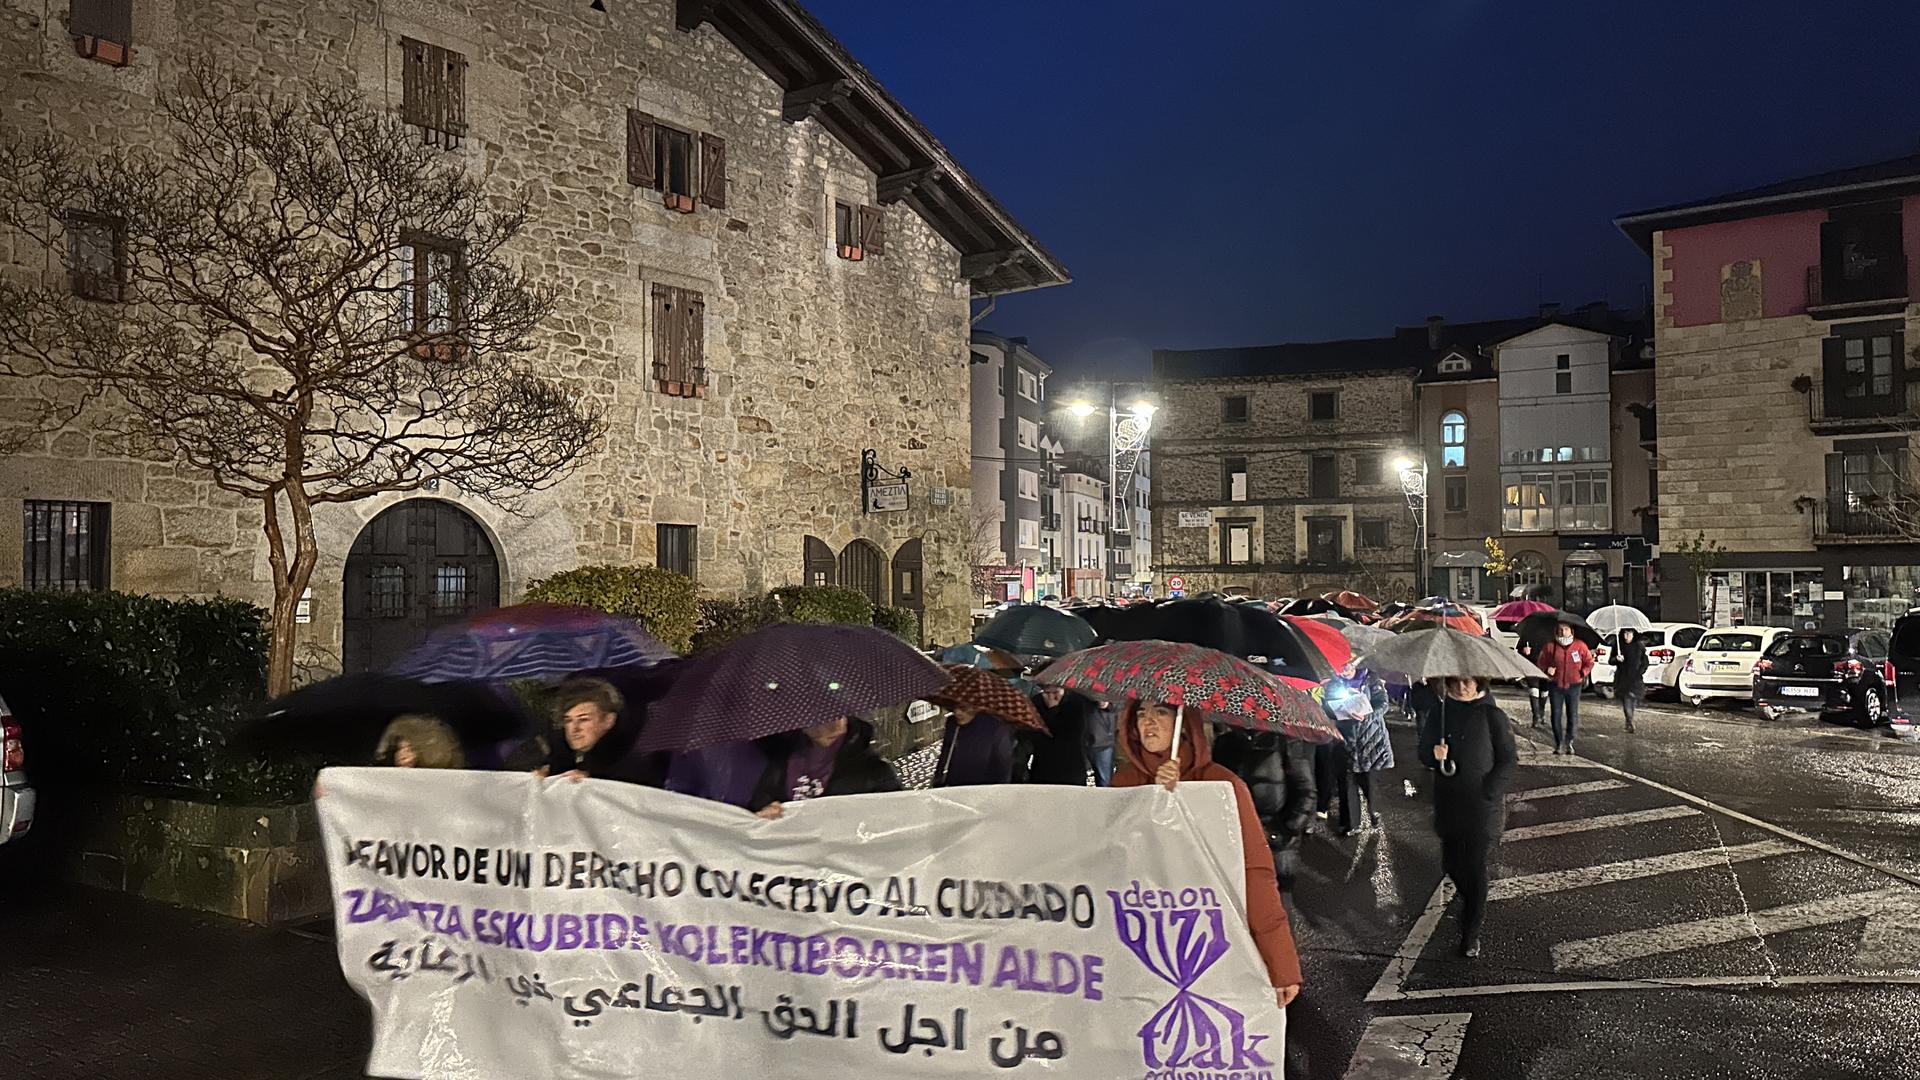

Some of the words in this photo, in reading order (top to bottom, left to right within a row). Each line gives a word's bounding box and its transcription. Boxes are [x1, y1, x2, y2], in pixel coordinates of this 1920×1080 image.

[870, 486, 906, 497] AMEZTIA
[453, 846, 490, 885] DE
[496, 848, 531, 889] UN
[544, 852, 684, 898] DERECHO
[881, 876, 931, 917] AL
[937, 878, 1095, 928] CUIDADO
[1123, 880, 1221, 909] denon
[473, 908, 649, 952] ESKUBIDE
[654, 919, 984, 986] KOLEKTIBOAREN
[992, 944, 1106, 1001] ALDE
[761, 994, 858, 1040] الحق
[989, 1017, 1065, 1068] من
